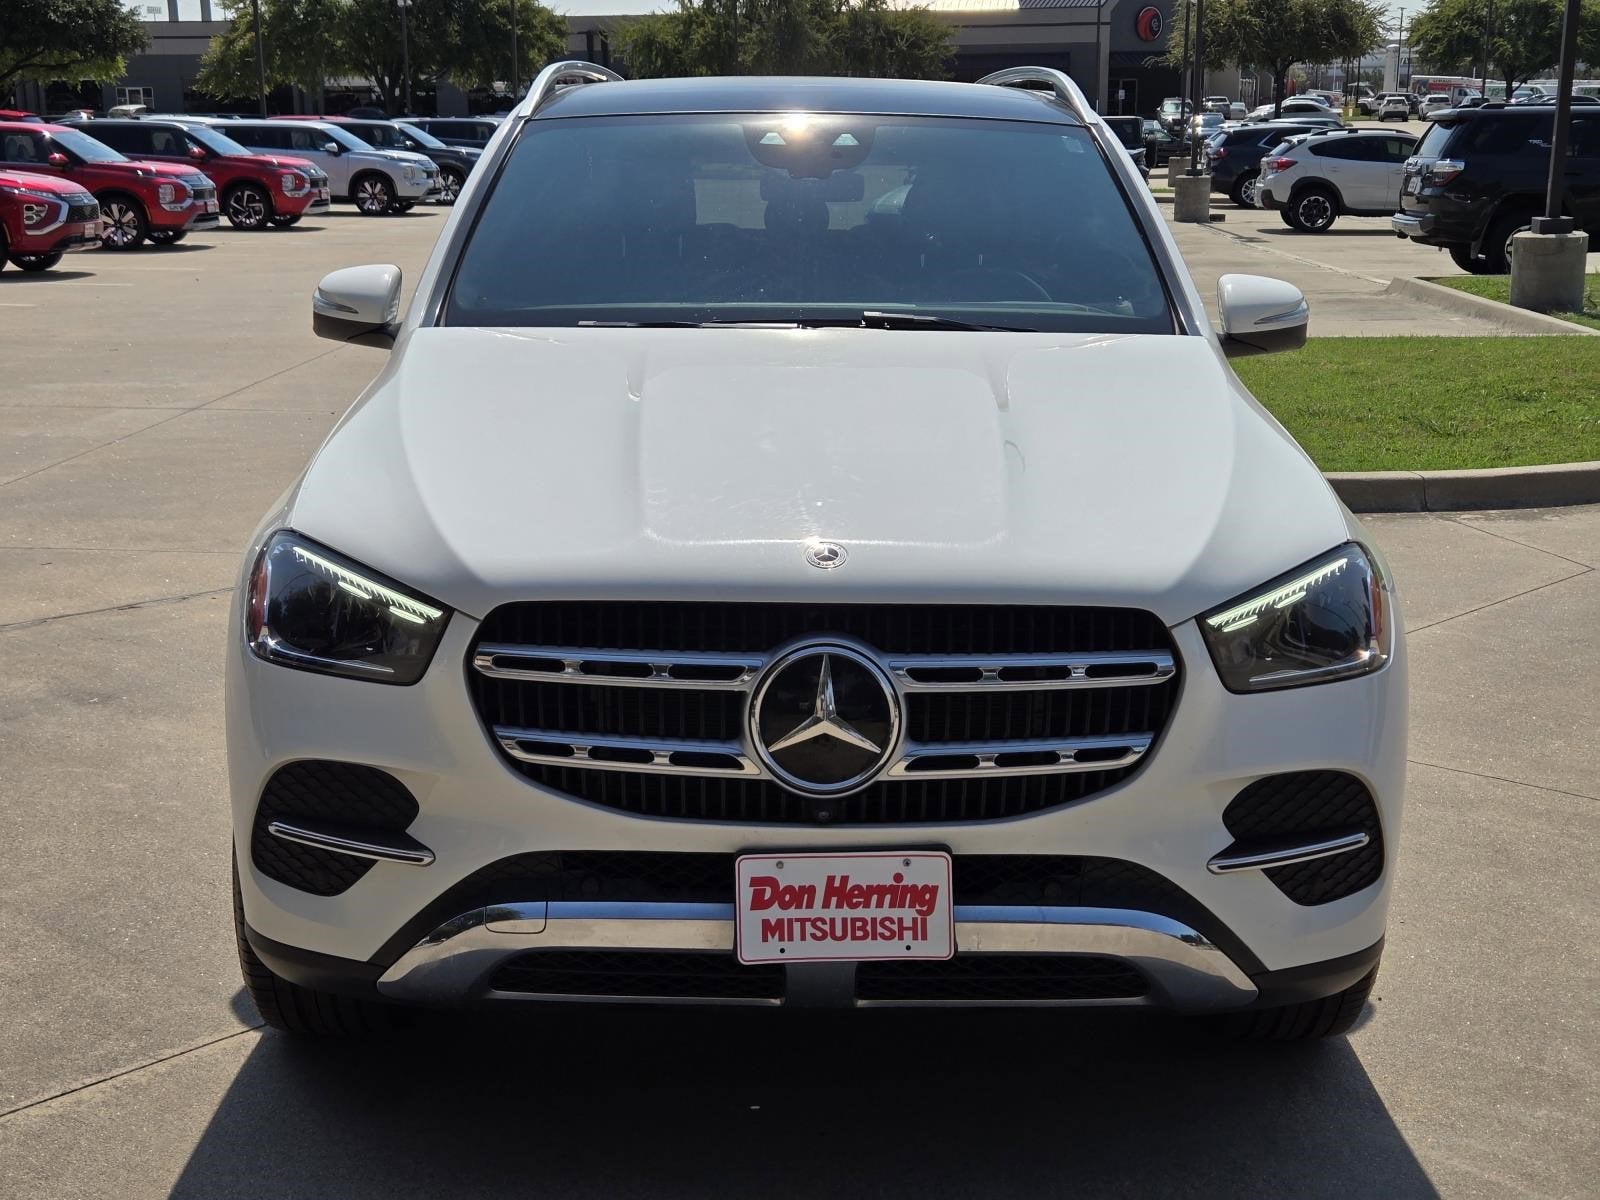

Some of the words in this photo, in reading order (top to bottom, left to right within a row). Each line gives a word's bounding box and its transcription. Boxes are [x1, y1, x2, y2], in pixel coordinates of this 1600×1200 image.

[749, 876, 817, 911] Don
[821, 872, 939, 917] Herring
[761, 916, 928, 943] MITSUBISHI
